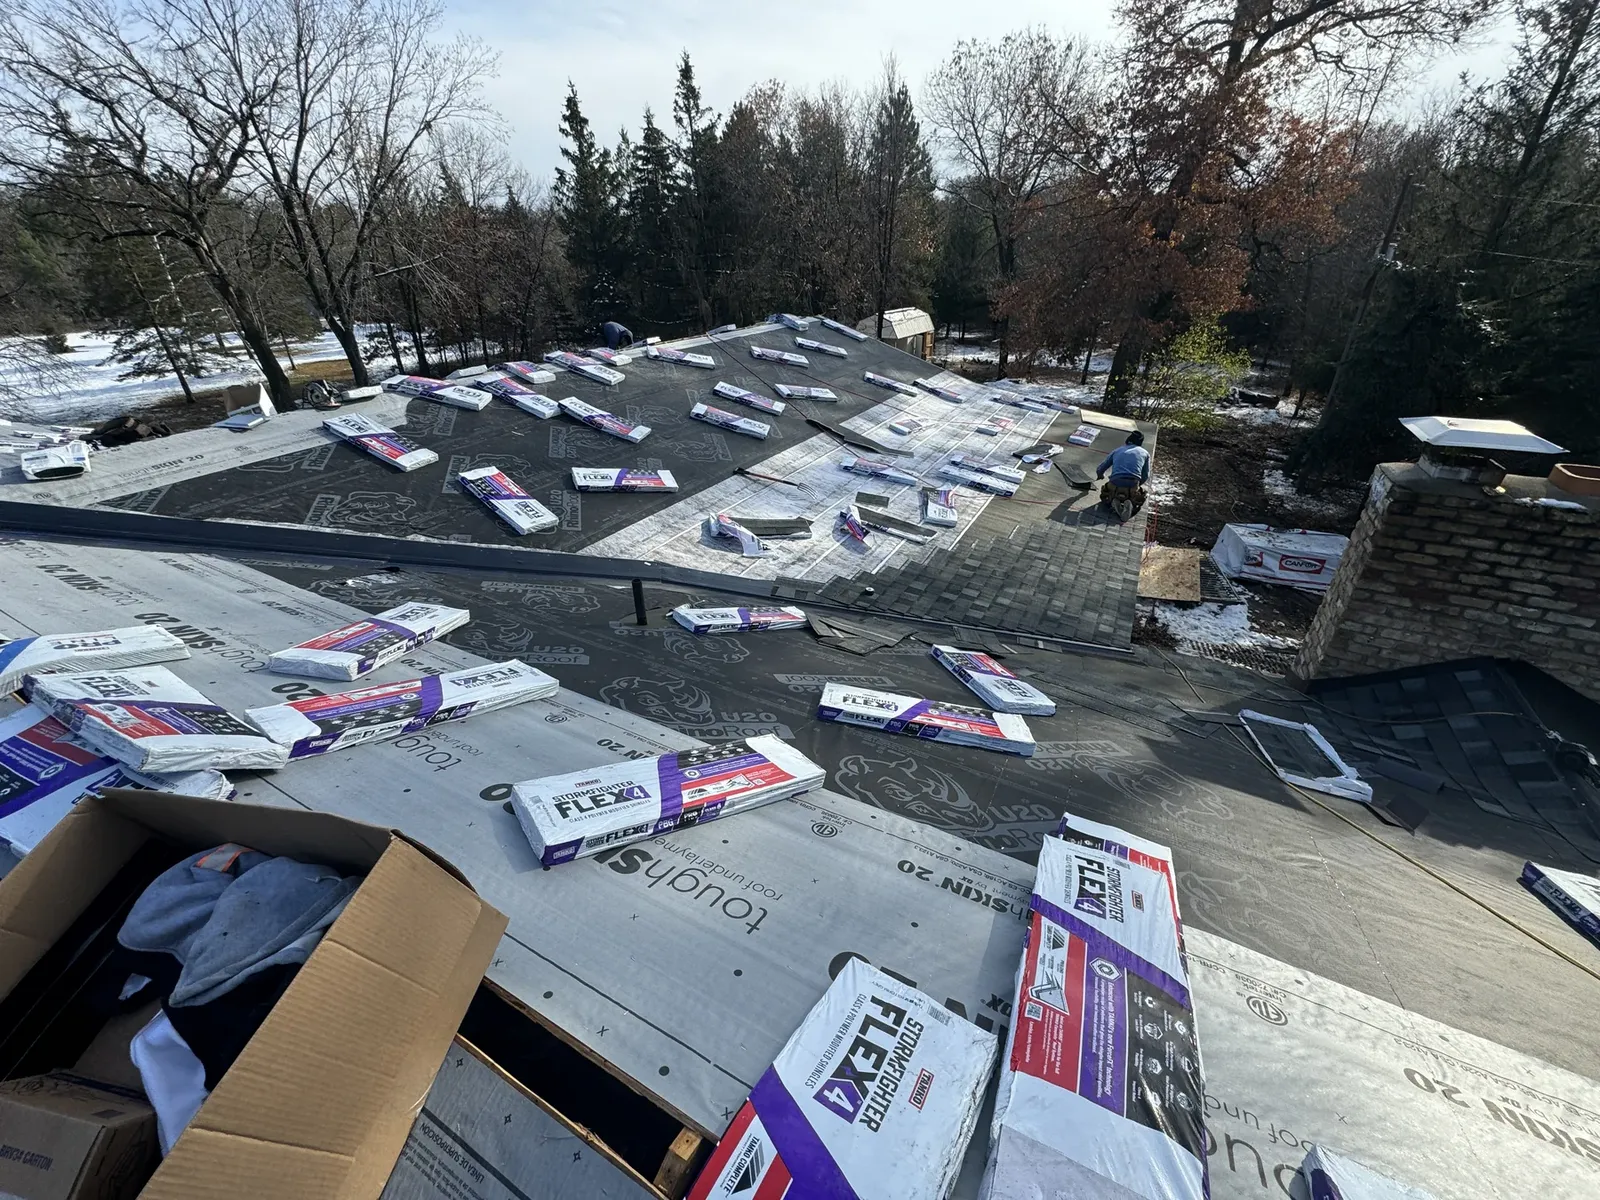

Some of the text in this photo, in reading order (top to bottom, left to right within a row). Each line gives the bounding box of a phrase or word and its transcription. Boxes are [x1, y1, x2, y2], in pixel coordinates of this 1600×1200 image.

[720, 712, 778, 723] U20
[597, 738, 625, 752] 20
[552, 780, 635, 802] STORMFIGHTER
[554, 786, 651, 819] FLEX4
[658, 820, 674, 830] PBG
[988, 804, 1055, 821] U20
[651, 836, 784, 901] roof underlayme
[897, 859, 934, 882] 20
[1107, 866, 1124, 923] STORMFIGHTER
[853, 994, 867, 1009] CLASS
[1241, 982, 1283, 1003] Intertek
[838, 1010, 857, 1034] POLYMER
[1251, 998, 1284, 1022] ETL
[812, 995, 908, 1124] FLEX4
[823, 1032, 842, 1064] MODIFIED
[804, 1059, 828, 1089] SHINGLES
[859, 1017, 924, 1132] STORMFIGHTER
[911, 1070, 932, 1107] TAMKO
[1404, 1068, 1472, 1108] 20
[22, 1151, 54, 1170] CARTON
[420, 1122, 484, 1183] LÍNEA DE SUPERPOSICIÓN
[724, 1136, 760, 1194] TAMKO COMPLETE
